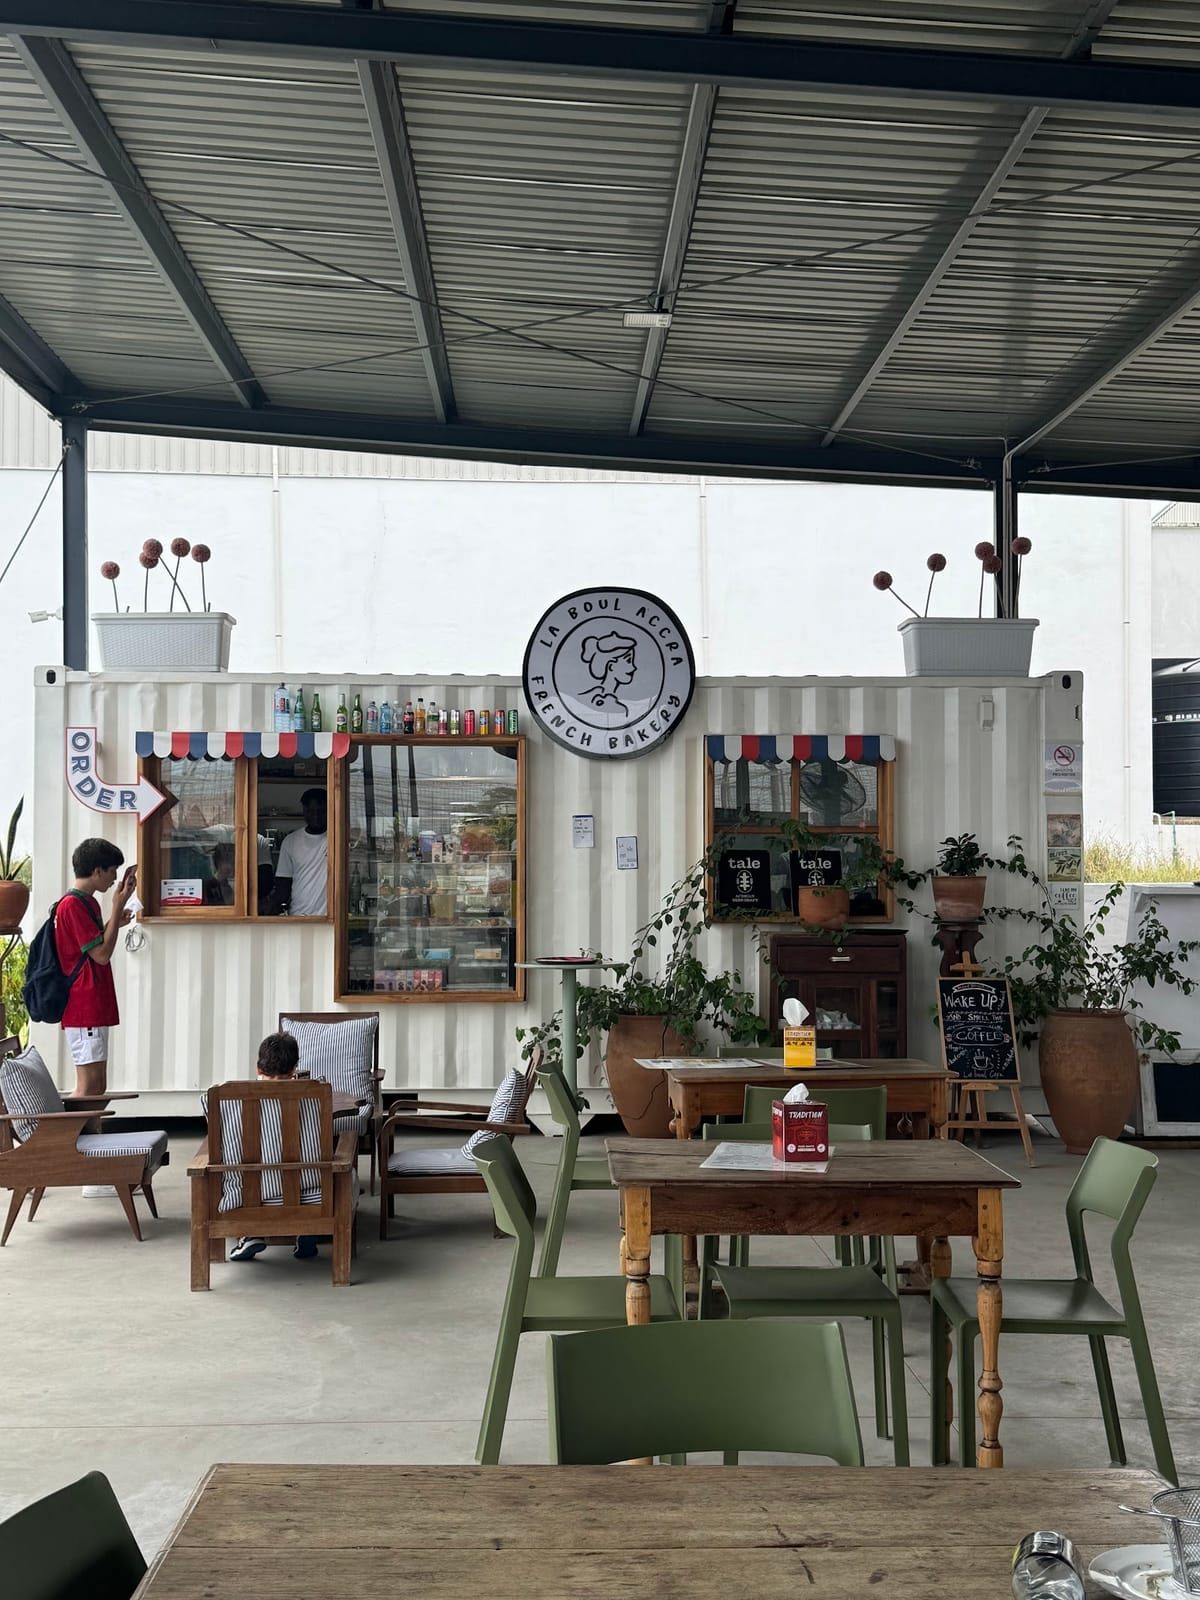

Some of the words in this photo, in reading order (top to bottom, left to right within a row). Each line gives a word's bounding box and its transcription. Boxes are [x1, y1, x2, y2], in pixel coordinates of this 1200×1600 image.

[540, 626, 560, 648] LA
[568, 598, 621, 620] BOUL
[636, 606, 683, 666] ACCRA
[532, 675, 592, 746] FRENCH
[608, 695, 680, 749] BAKERY
[71, 731, 137, 809] ORDER
[728, 857, 761, 869] tale
[800, 858, 832, 869] tale
[943, 992, 976, 1009] WAKE
[968, 1013, 989, 1021] SMELL
[956, 1031, 1001, 1041] COFFEE
[789, 1111, 823, 1119] TRADITION
